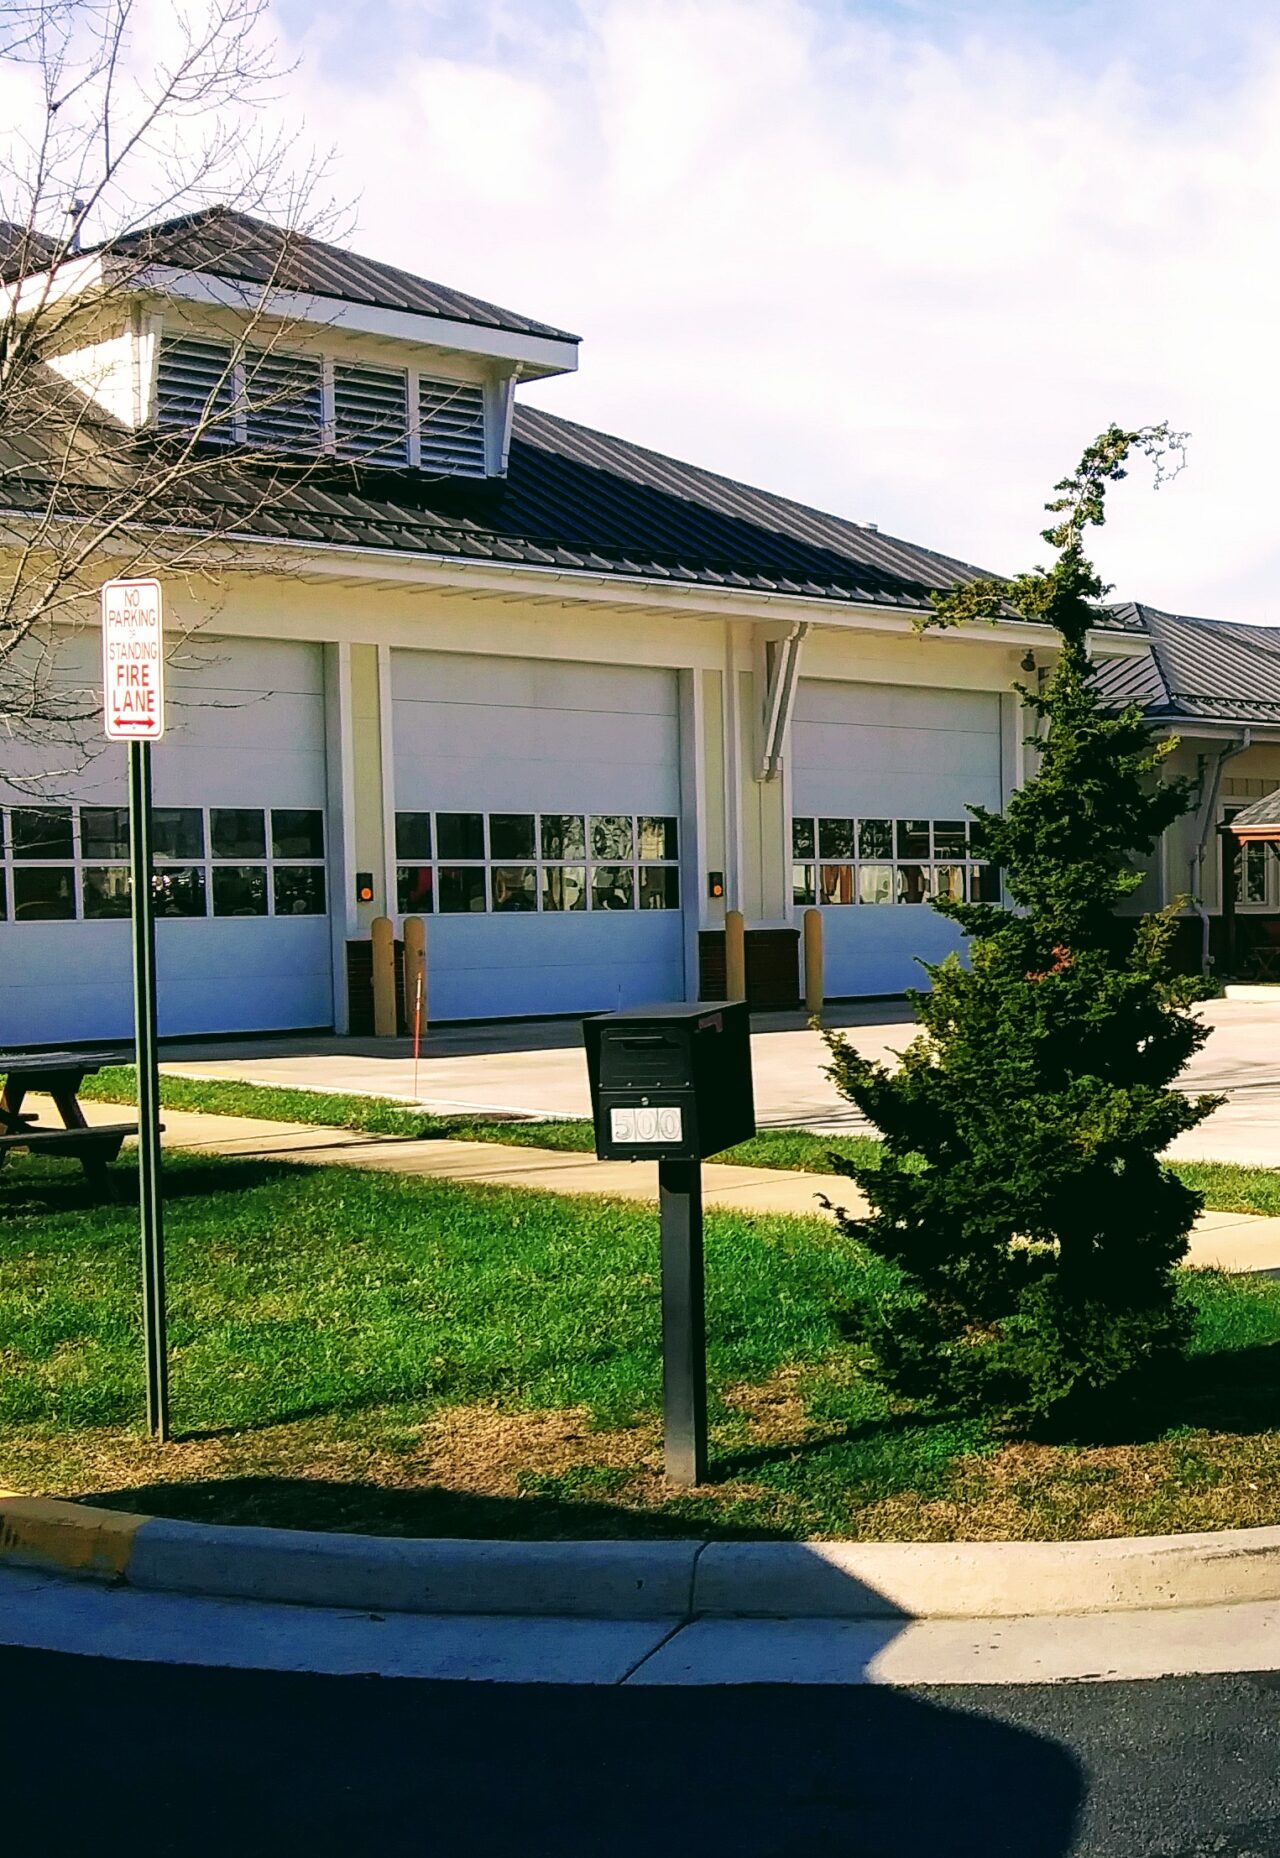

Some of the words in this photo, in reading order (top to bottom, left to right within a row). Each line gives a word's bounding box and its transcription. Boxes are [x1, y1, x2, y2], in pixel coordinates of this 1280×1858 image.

[125, 589, 140, 607] NO
[109, 609, 156, 627] PARKING
[109, 642, 157, 660] STANDING
[117, 664, 149, 687] FIRE
[113, 689, 154, 712] LANE
[615, 1110, 680, 1140] 500
